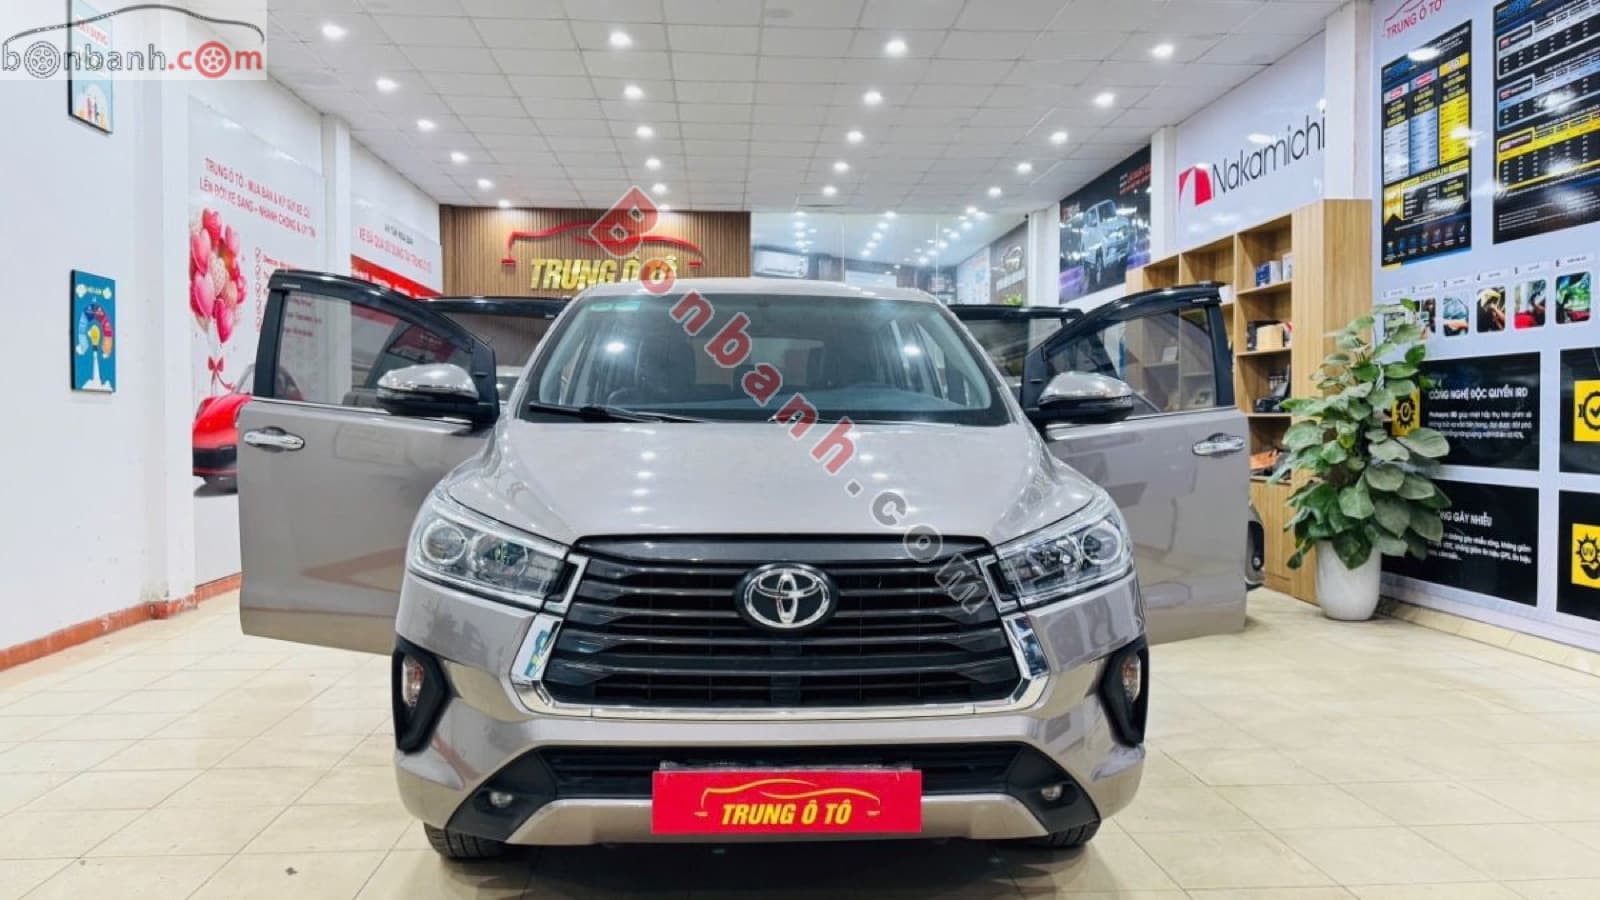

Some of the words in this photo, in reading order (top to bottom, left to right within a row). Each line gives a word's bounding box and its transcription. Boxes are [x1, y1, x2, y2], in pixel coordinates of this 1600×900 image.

[1386, 13, 1417, 38] TRUNG
[1212, 110, 1326, 197] Nakamichi
[530, 258, 618, 290] TRUNG
[620, 255, 640, 282] Ô
[1428, 388, 1449, 400] CÔNG
[1450, 387, 1469, 400] NGHỆ
[1470, 387, 1487, 400] ĐỘC
[1488, 384, 1513, 399] QUYỀN
[1515, 387, 1528, 398] IRD
[1453, 510, 1469, 523] GÂY
[722, 803, 796, 825] TRUNG
[801, 799, 818, 825] Ô
[824, 799, 852, 825] TÔ
